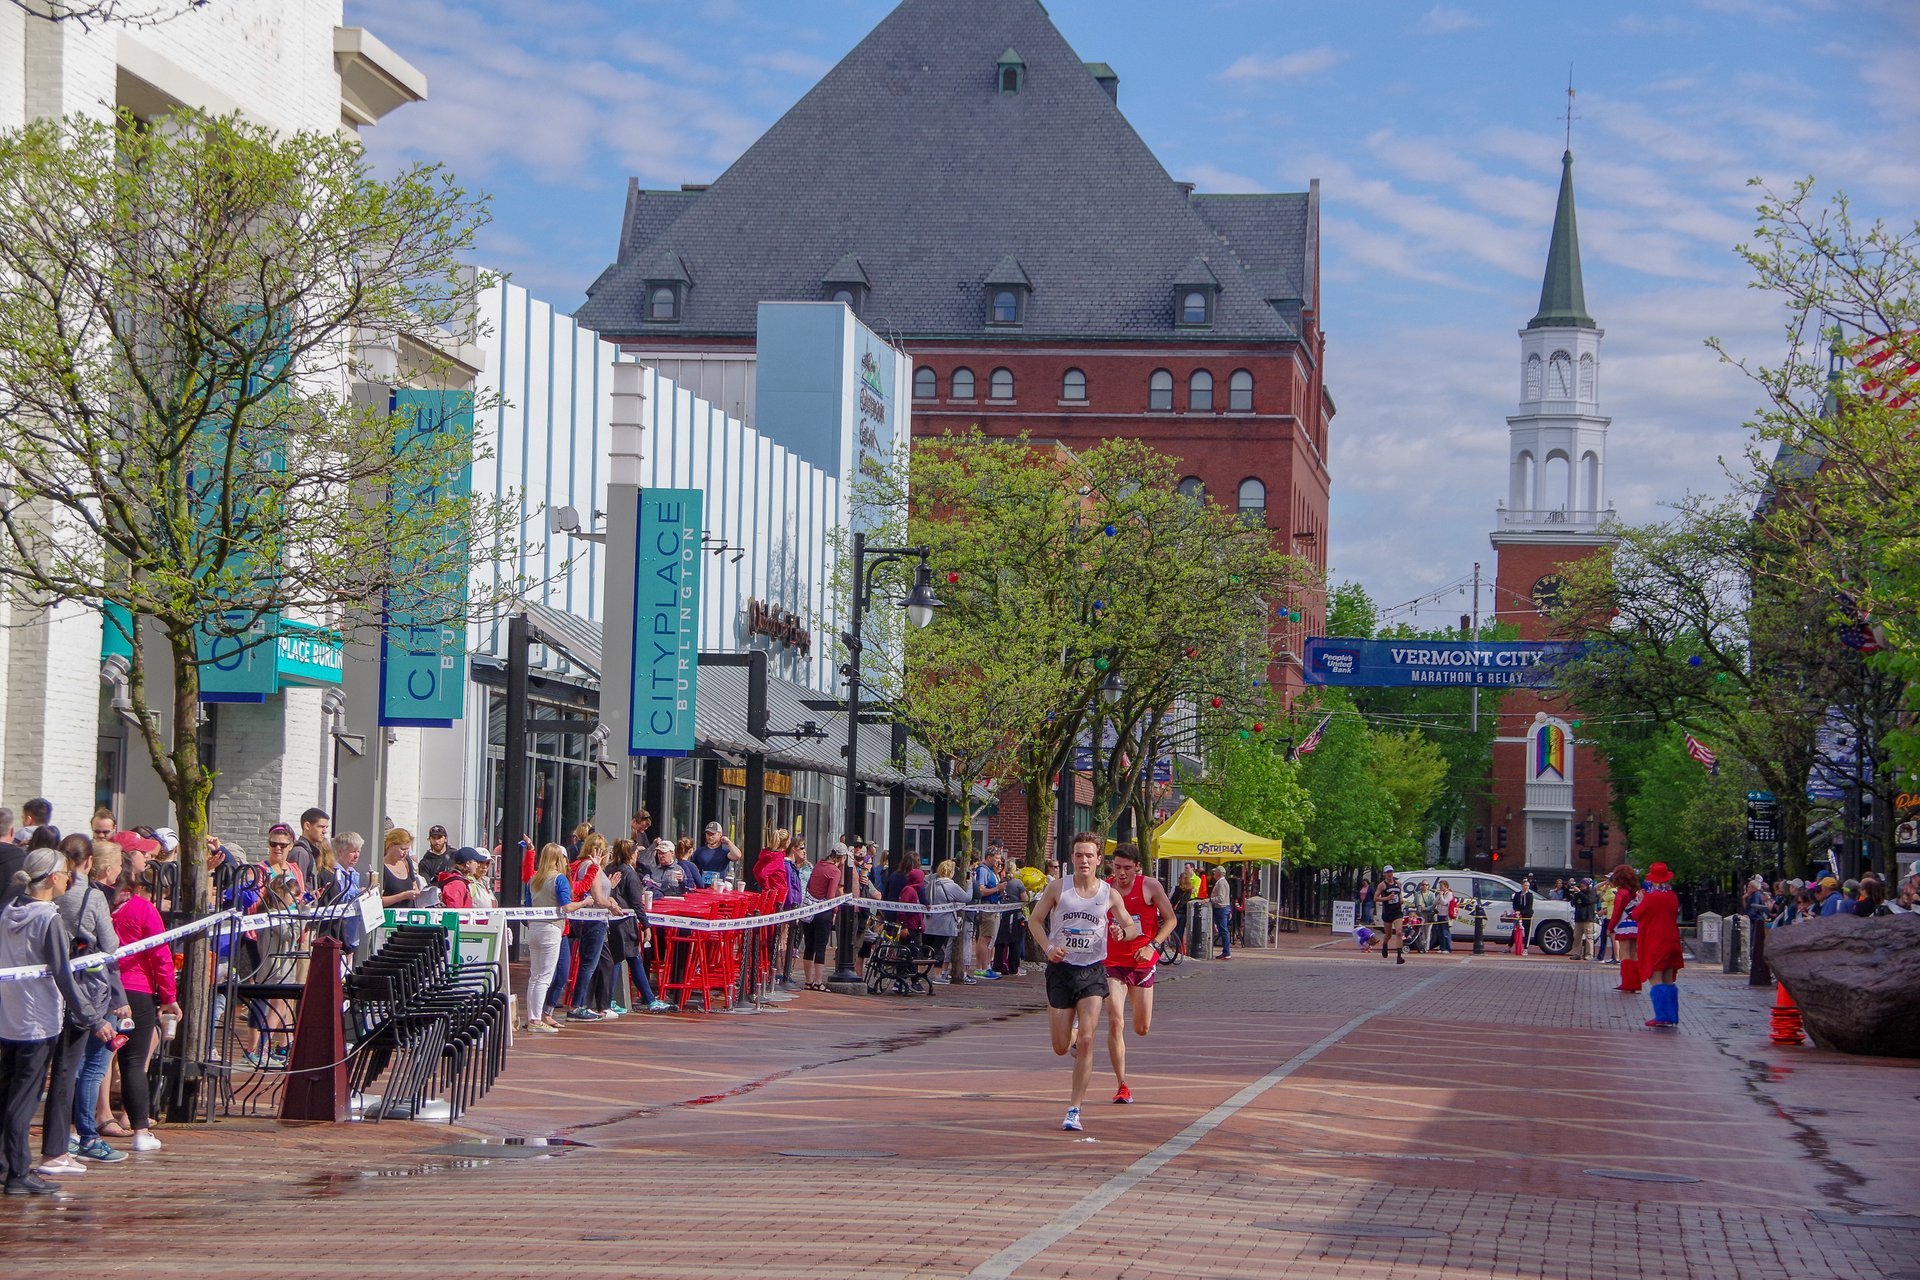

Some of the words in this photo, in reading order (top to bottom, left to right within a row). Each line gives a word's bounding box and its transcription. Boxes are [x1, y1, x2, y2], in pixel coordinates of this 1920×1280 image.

[650, 502, 681, 736] CITYPLACE
[677, 528, 694, 711] BURLINGTON
[1322, 653, 1353, 663] People's
[1327, 660, 1353, 668] United
[1391, 648, 1493, 667] VERMONT
[1496, 650, 1545, 667] CITY
[1411, 670, 1472, 683] MARATHON
[1477, 673, 1484, 683] &
[1488, 672, 1523, 684] RELAY
[1063, 911, 1100, 926] BOWDOIN
[1065, 937, 1090, 949] 2892
